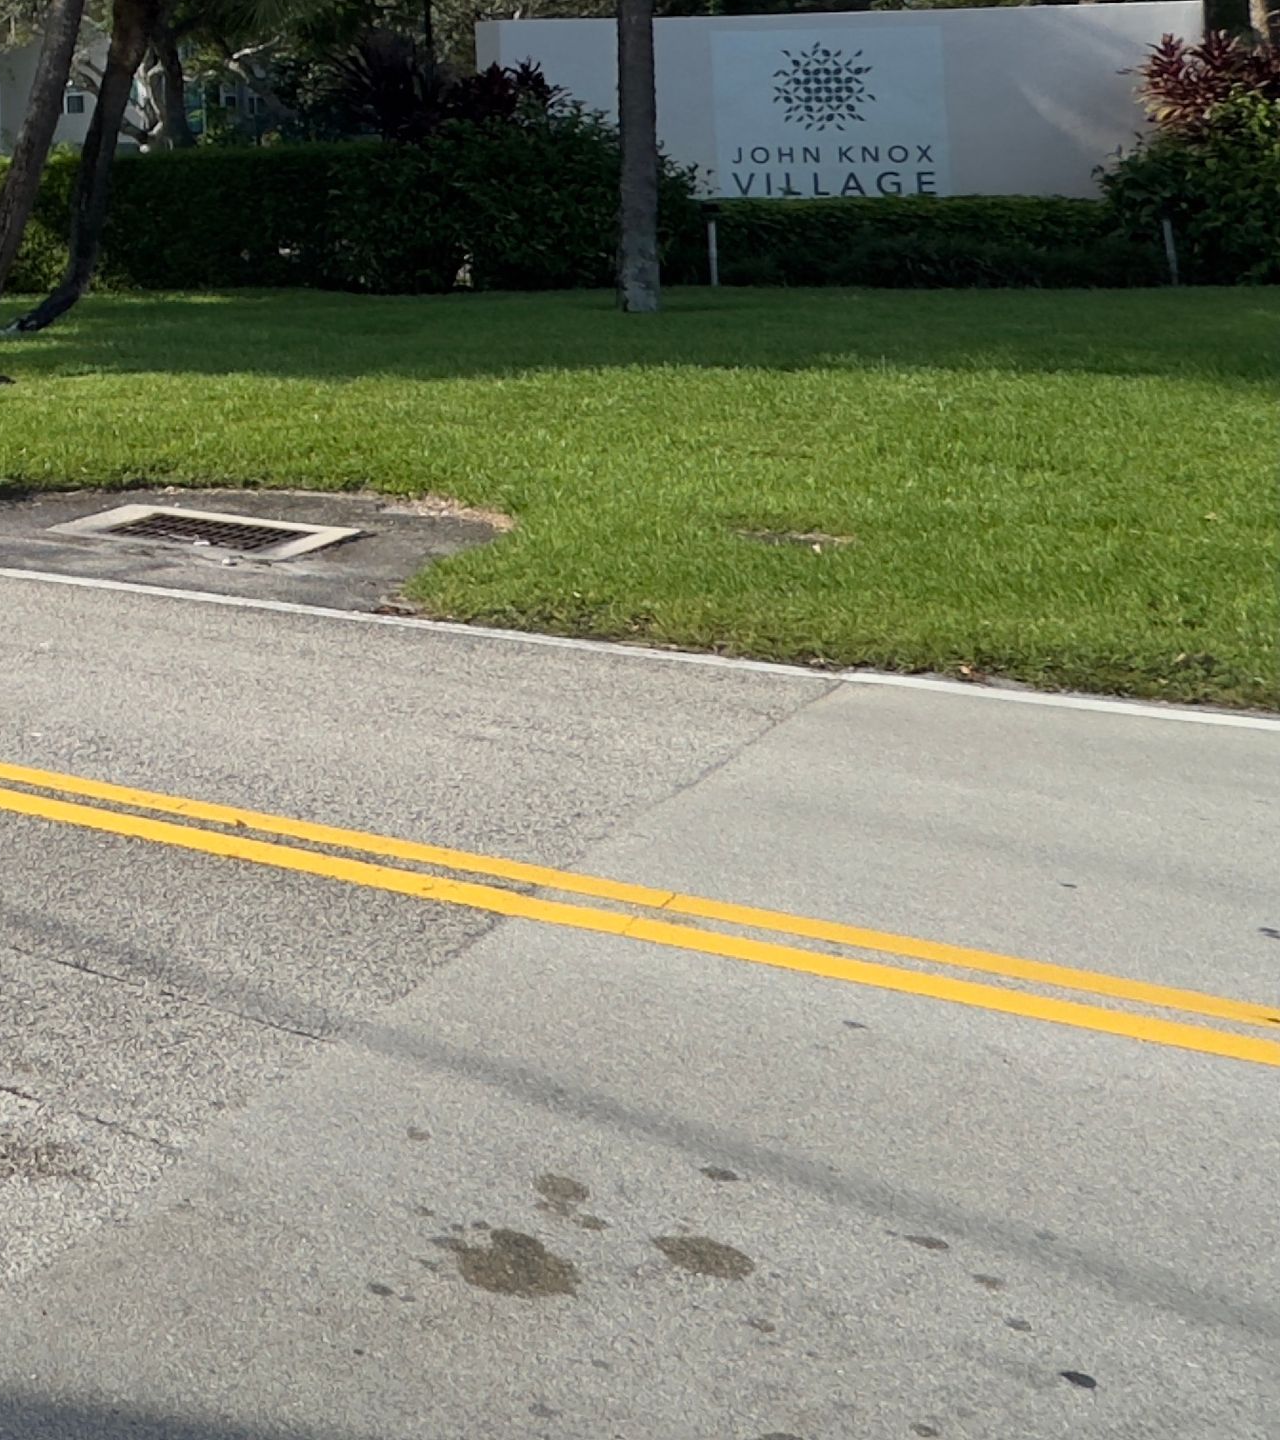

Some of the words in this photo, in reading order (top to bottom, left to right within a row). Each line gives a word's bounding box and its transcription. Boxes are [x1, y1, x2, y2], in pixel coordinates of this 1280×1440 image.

[731, 145, 821, 165] JOHN
[837, 144, 934, 164] KNOX
[730, 171, 938, 196] VILLAGE
